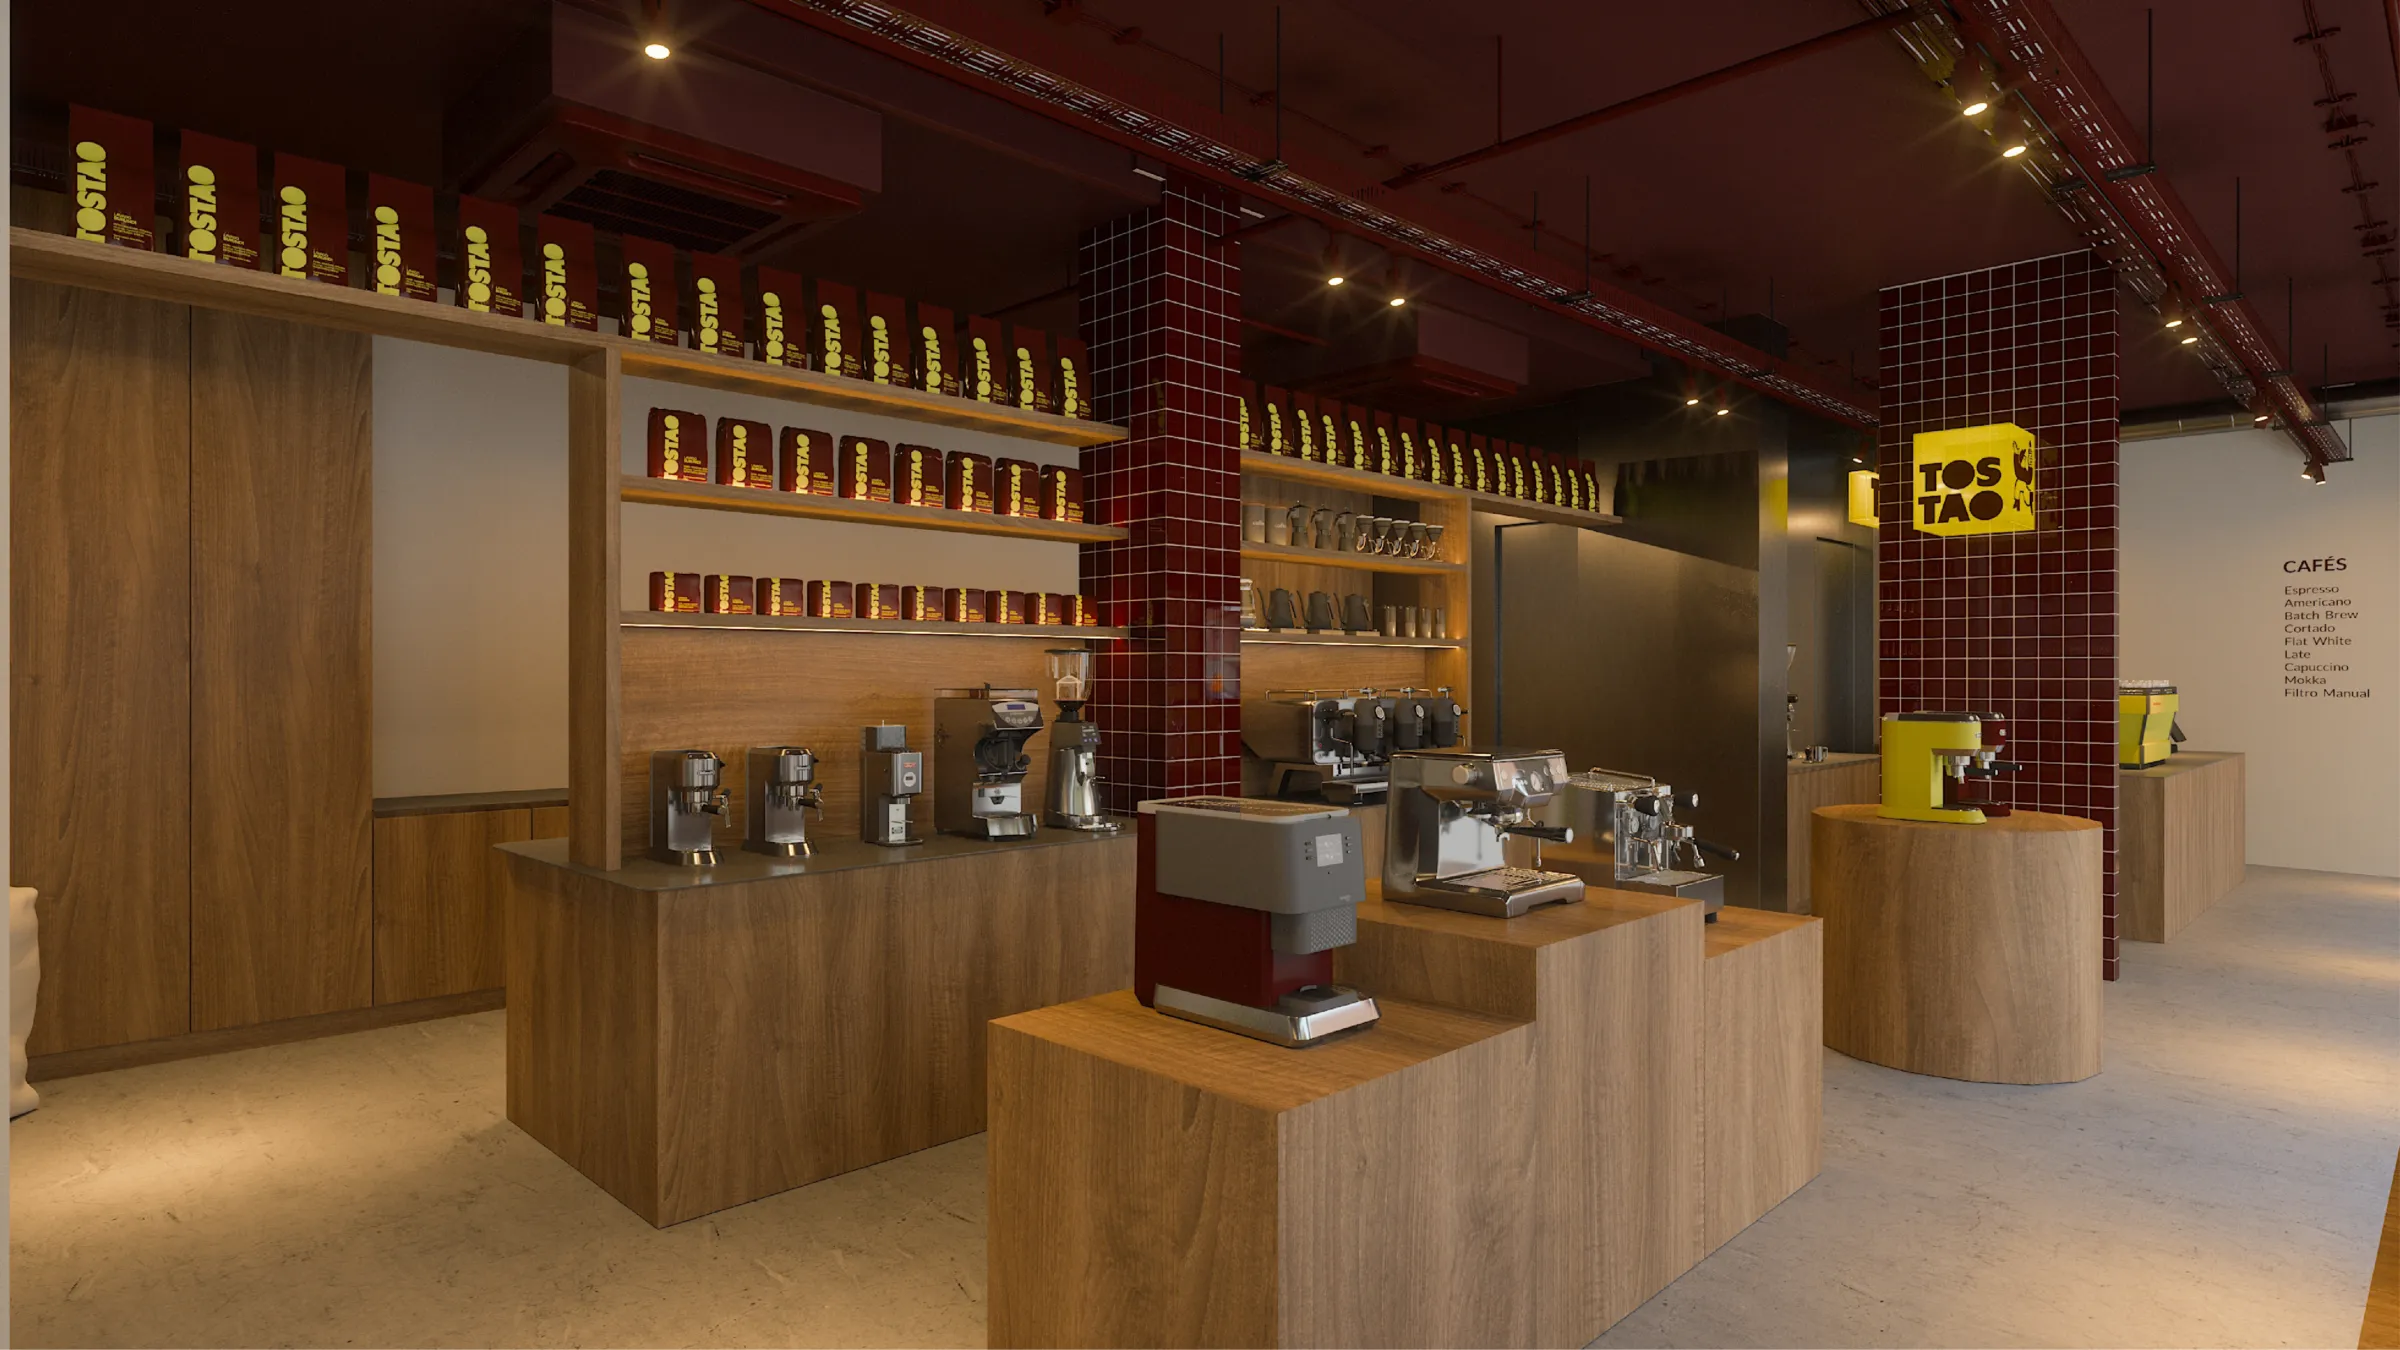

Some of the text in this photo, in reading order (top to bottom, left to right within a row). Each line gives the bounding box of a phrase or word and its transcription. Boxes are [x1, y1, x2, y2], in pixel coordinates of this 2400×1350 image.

[1918, 457, 2002, 492] TOS
[1918, 490, 2004, 525] TAO
[2283, 556, 2348, 574] CAFÉS
[2284, 585, 2340, 597] Espresso
[2284, 598, 2352, 608] Americano
[2284, 610, 2359, 621] Batch Brew
[2284, 623, 2336, 634] Cortado
[2284, 636, 2352, 646] Flat White
[2284, 649, 2311, 659] Late
[2284, 662, 2349, 673] Capuccino
[2284, 675, 2327, 685] Mokka
[2284, 688, 2370, 699] Filtro Manual
